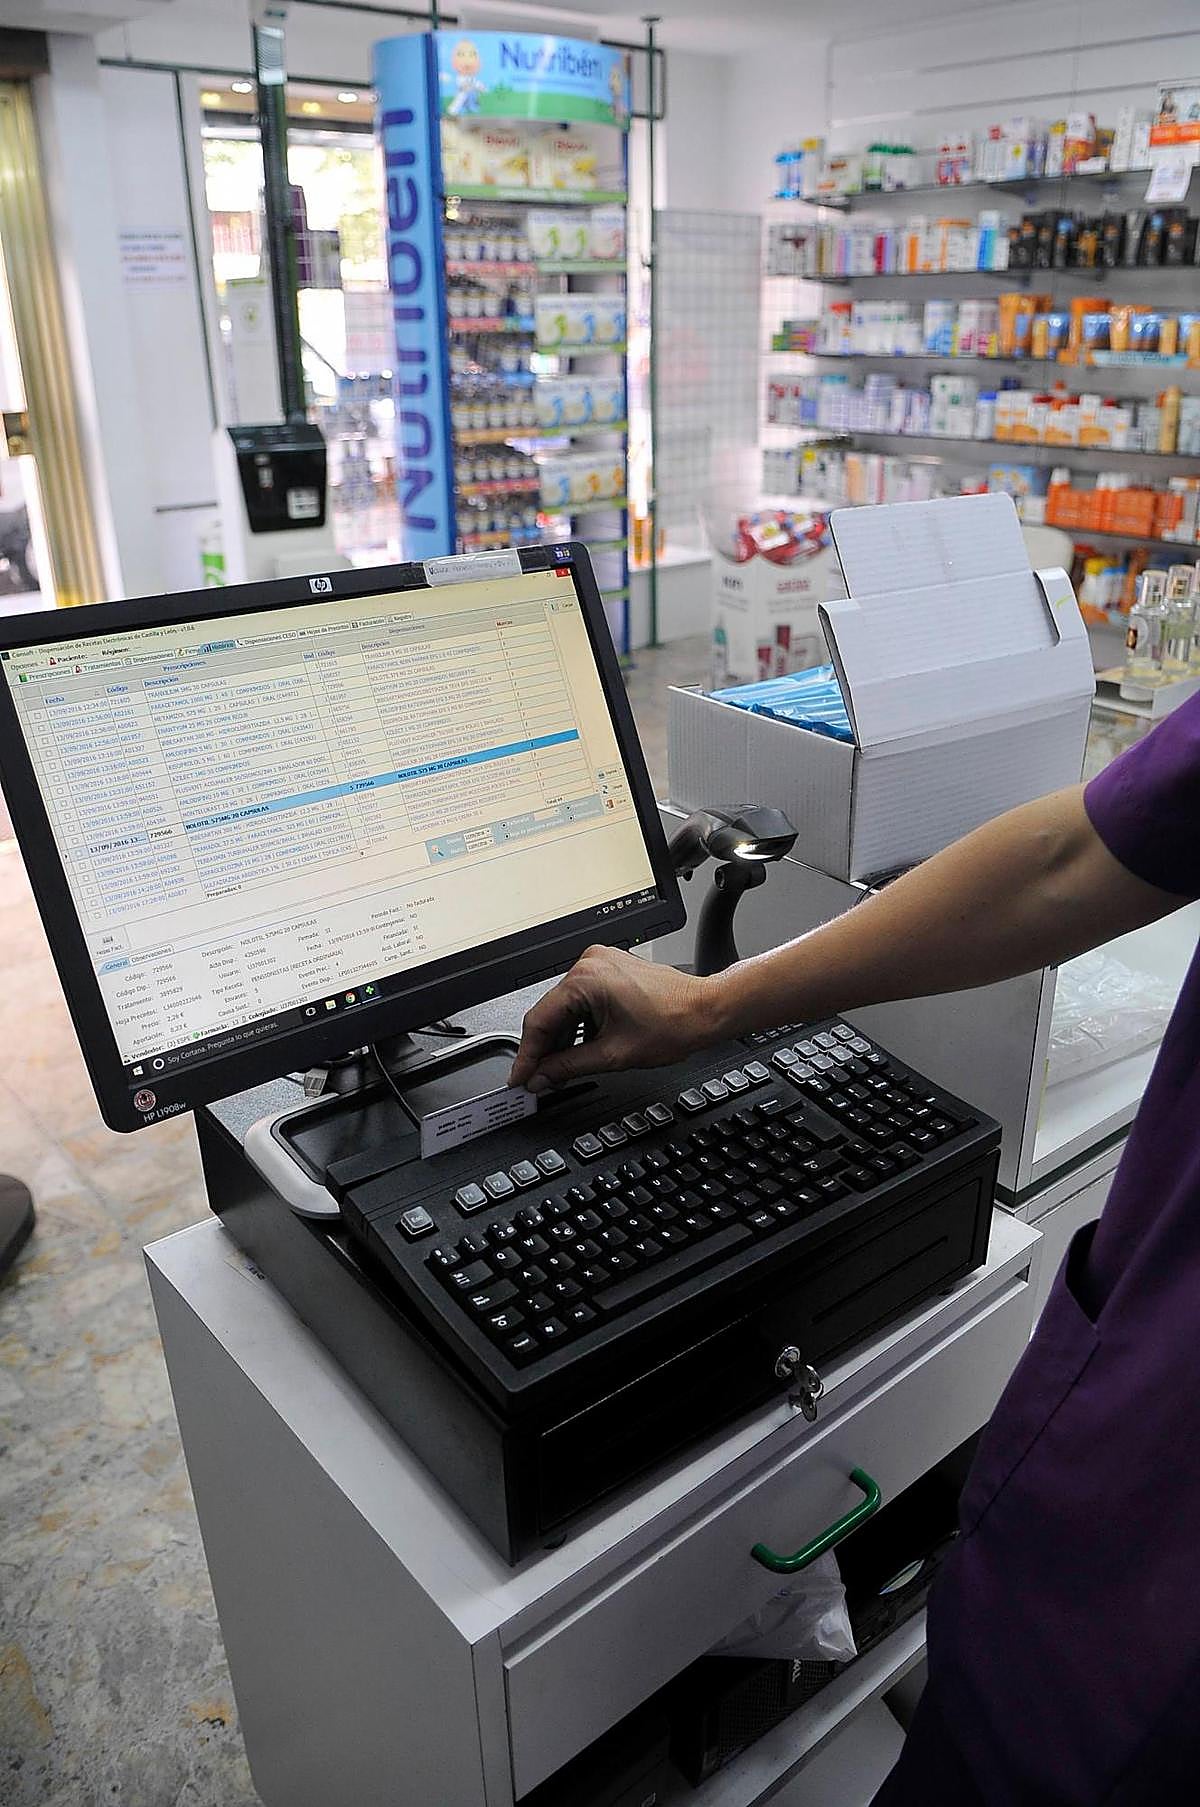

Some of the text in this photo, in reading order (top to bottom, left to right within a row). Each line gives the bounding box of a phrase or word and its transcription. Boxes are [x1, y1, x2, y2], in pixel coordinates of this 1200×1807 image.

[57, 653, 88, 663] Paciente:
[132, 651, 174, 664] Dispensaciones
[83, 660, 121, 671] Tratamientos
[162, 659, 207, 672] Prescripciones
[28, 668, 71, 681] Prescripciones
[143, 675, 179, 688] Descripción
[106, 684, 128, 694] Código
[44, 695, 65, 704] Fecha
[105, 959, 128, 971] General
[130, 1044, 164, 1060] Vendedor:
[167, 1054, 180, 1065] Soy
[206, 1034, 236, 1052] Pregunta
[242, 1029, 255, 1039] que
[143, 1102, 187, 1123] HP L1908w
